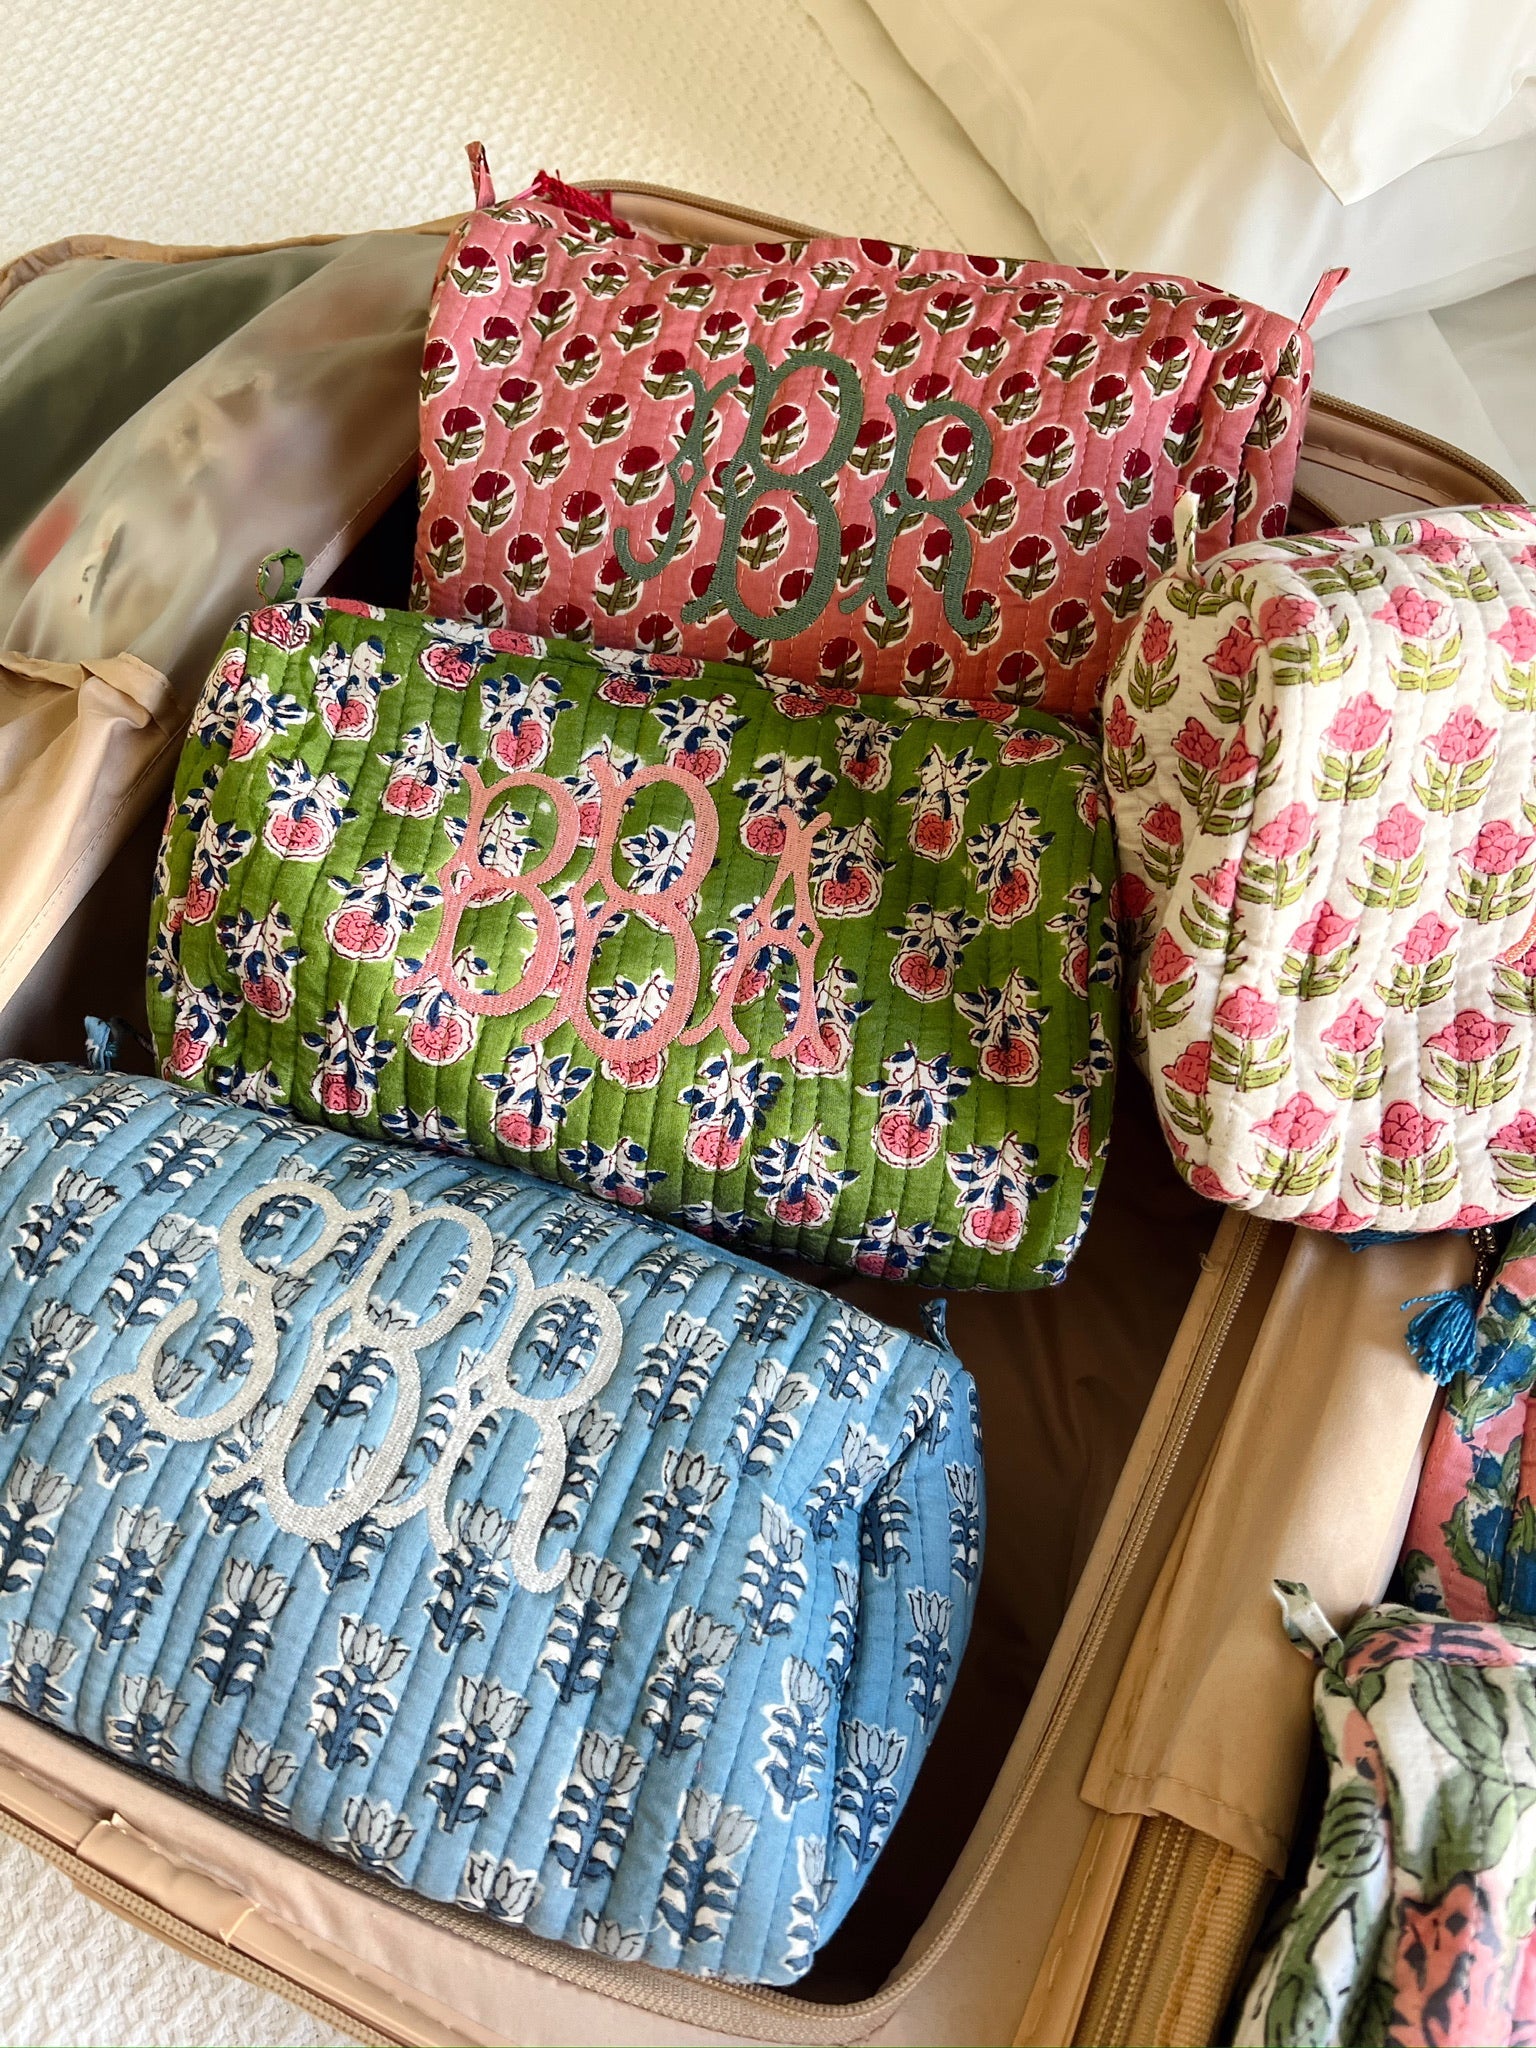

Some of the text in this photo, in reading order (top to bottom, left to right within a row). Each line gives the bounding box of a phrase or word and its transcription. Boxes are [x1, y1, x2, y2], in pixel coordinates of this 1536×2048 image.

[613, 344, 993, 640] JBR
[394, 755, 837, 1069] BBA
[91, 1179, 623, 1593] SBR
